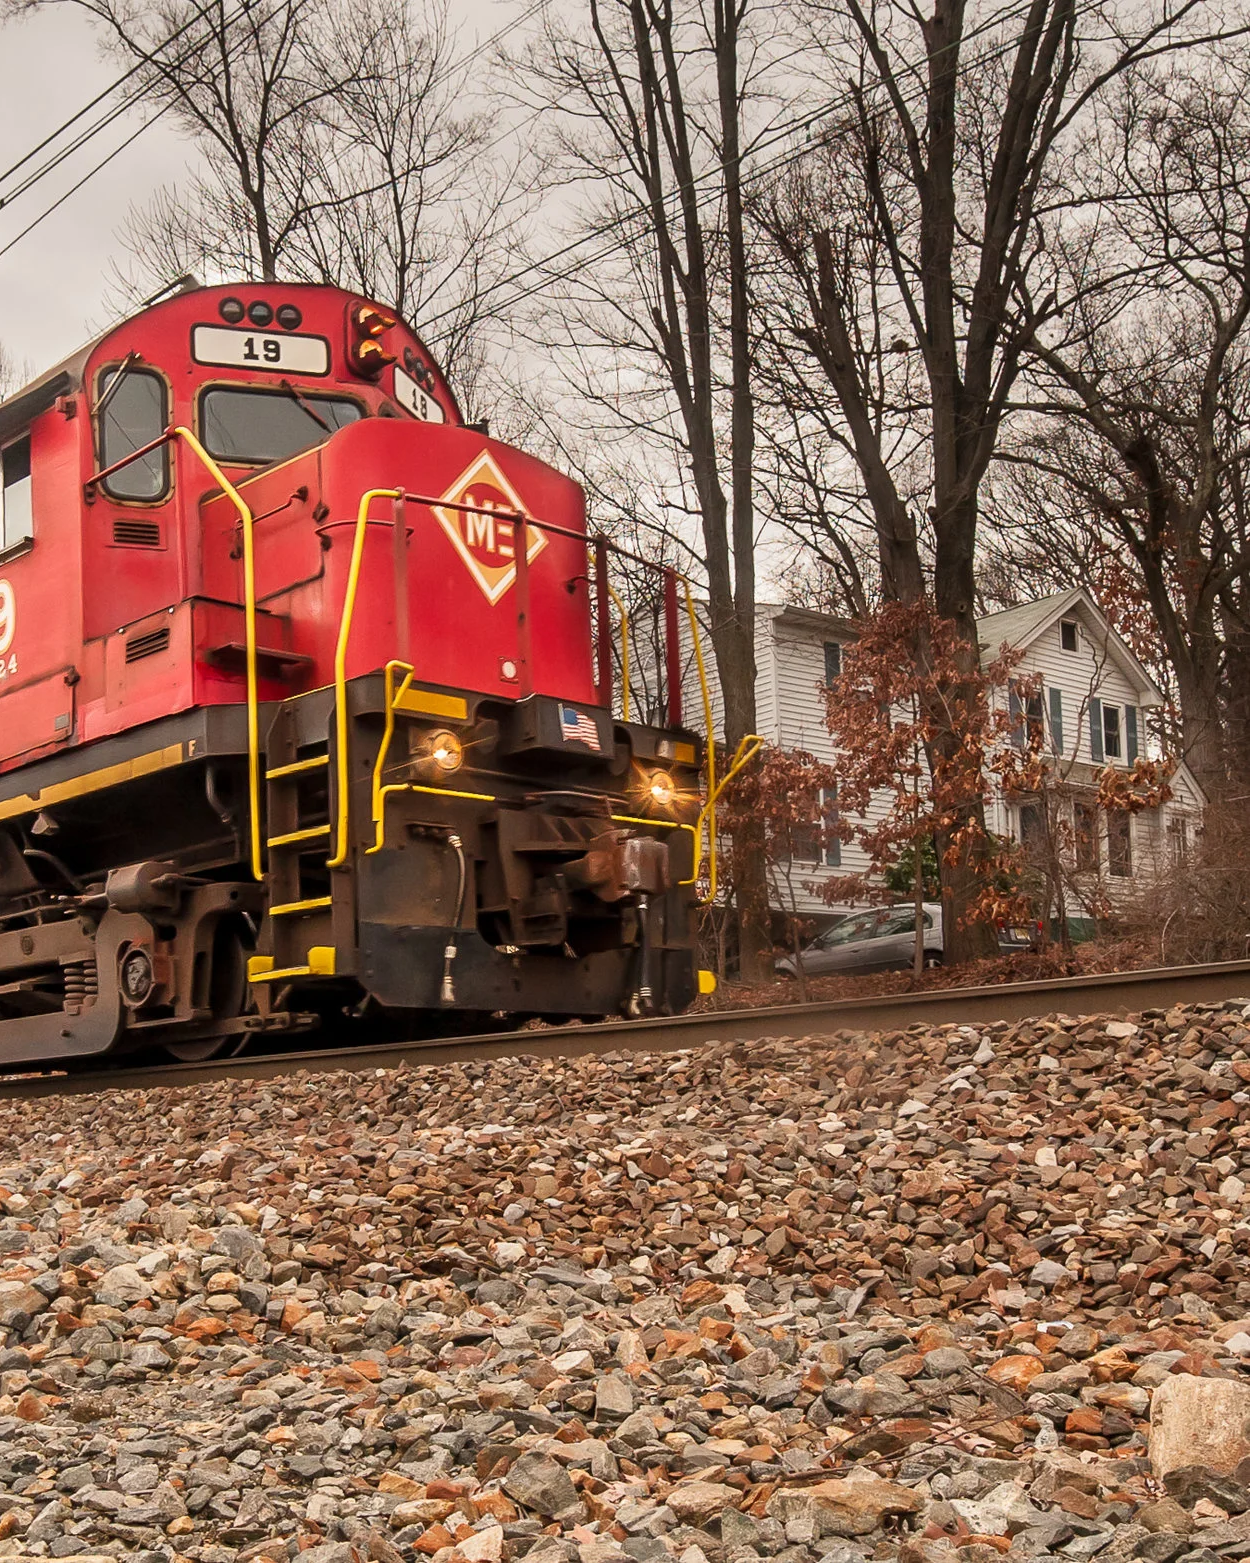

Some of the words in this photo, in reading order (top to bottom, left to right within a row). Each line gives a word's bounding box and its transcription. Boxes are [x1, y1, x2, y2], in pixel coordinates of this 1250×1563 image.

[243, 337, 281, 363] 19
[465, 493, 515, 558] ME
[188, 740, 197, 756] F
